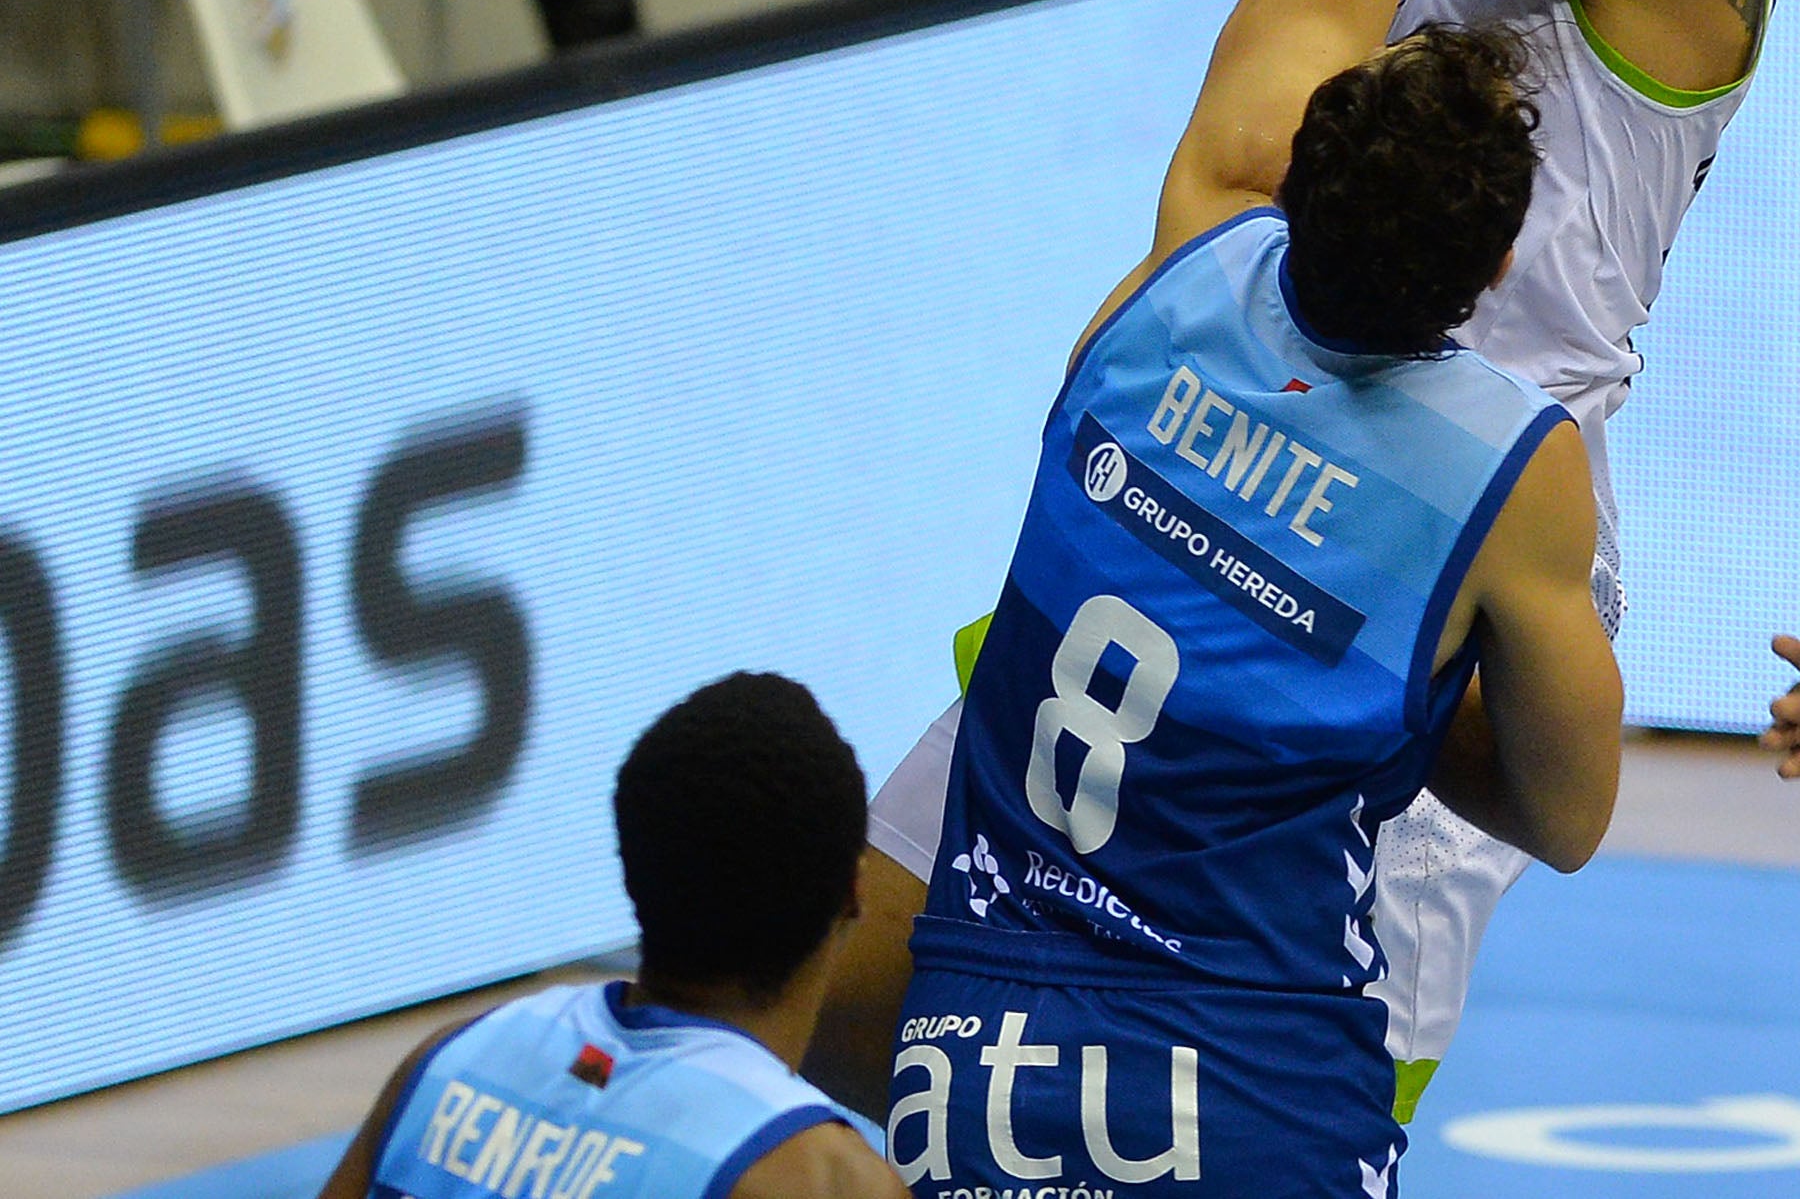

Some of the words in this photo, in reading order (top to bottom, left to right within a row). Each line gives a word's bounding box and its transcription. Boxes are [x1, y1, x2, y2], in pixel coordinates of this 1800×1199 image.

[1146, 364, 1360, 548] BENITE
[1123, 486, 1210, 557] GRUPO
[1210, 548, 1317, 635] HEREDA
[1025, 594, 1180, 855] 8
[887, 1010, 1201, 1188] atu
[901, 1014, 982, 1043] GRUPO
